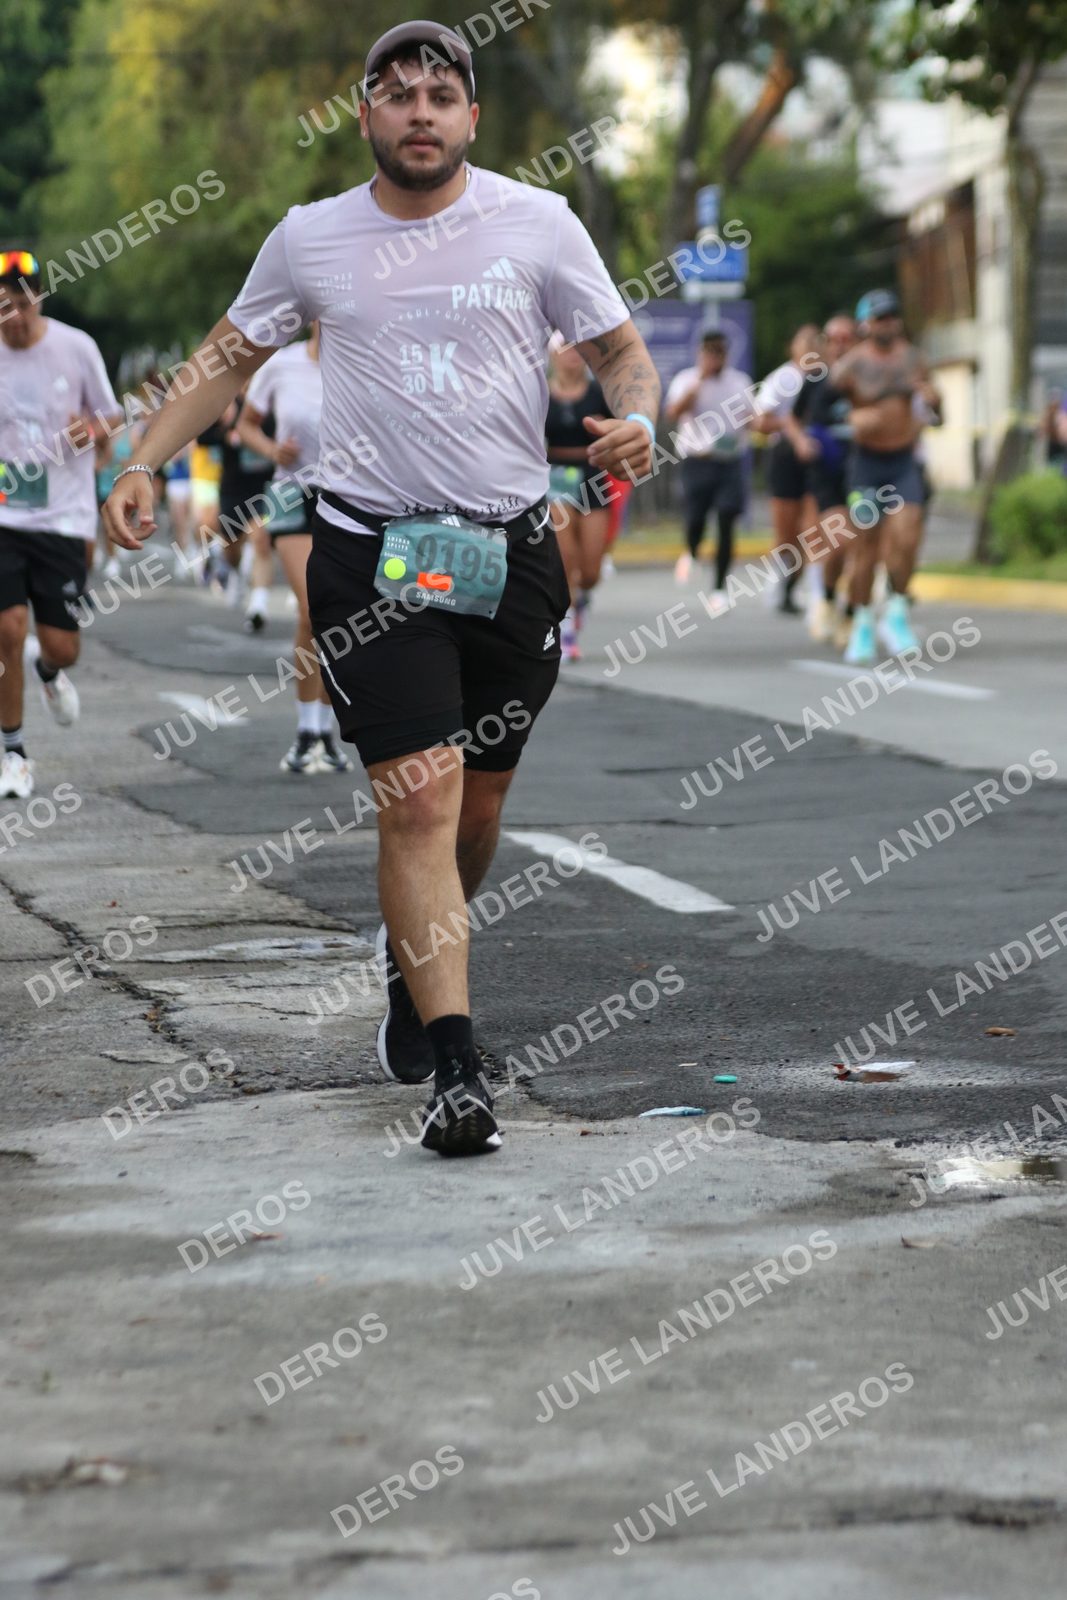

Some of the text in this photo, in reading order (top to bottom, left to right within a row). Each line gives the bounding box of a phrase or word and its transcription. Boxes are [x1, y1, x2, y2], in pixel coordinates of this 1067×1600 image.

[400, 344, 423, 365] 15
[429, 341, 464, 393] K
[402, 373, 426, 394] 30
[415, 534, 500, 586] 0195
[416, 592, 456, 606] SAMSUNG
